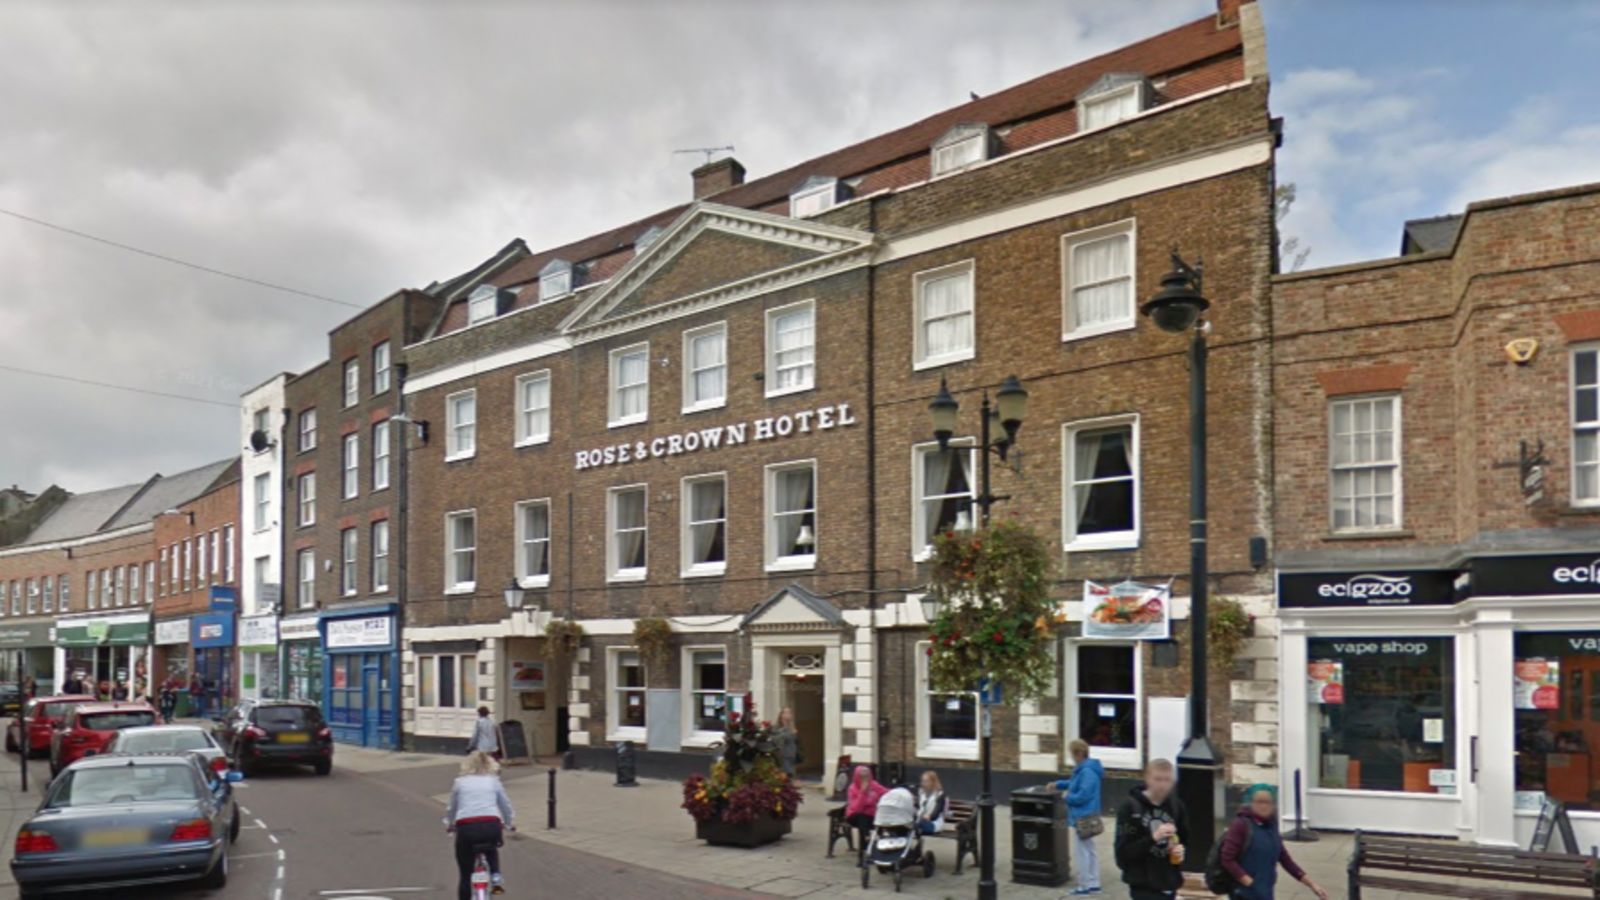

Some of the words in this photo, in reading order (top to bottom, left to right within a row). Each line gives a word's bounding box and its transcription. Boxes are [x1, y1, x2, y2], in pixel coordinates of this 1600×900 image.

[575, 445, 631, 470] ROSE
[634, 441, 647, 459] &
[651, 423, 748, 457] CROWN
[753, 404, 856, 440] HOTEL
[1318, 578, 1412, 599] ecigzoo
[1333, 642, 1378, 655] vape
[1381, 641, 1428, 655] shop
[1569, 639, 1600, 652] va
